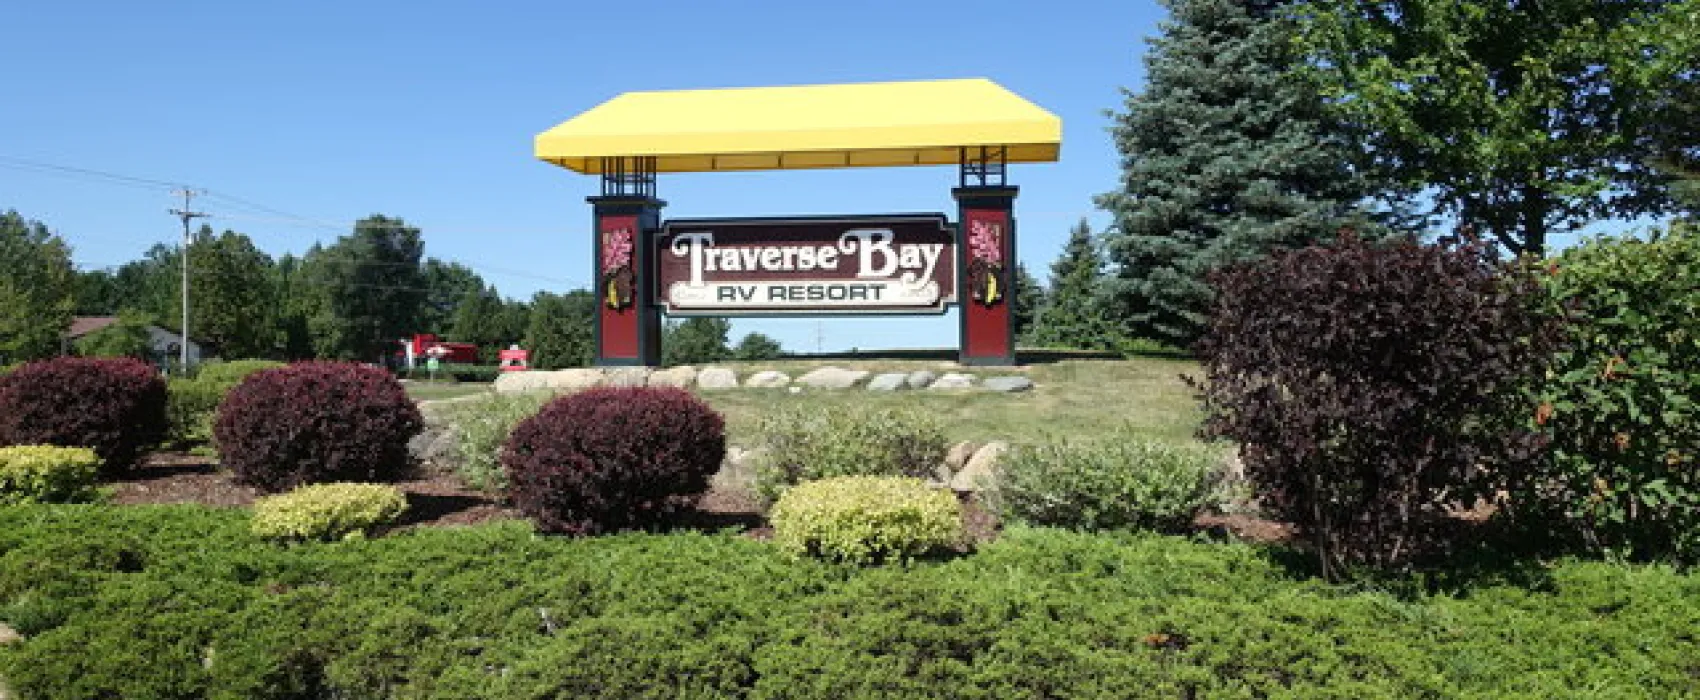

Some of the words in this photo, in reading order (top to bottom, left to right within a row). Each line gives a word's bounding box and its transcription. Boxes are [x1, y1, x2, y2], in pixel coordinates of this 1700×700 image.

[672, 232, 839, 287] Traverse
[839, 229, 944, 292] Bay
[717, 285, 757, 301] RV
[768, 284, 888, 300] RESORT
